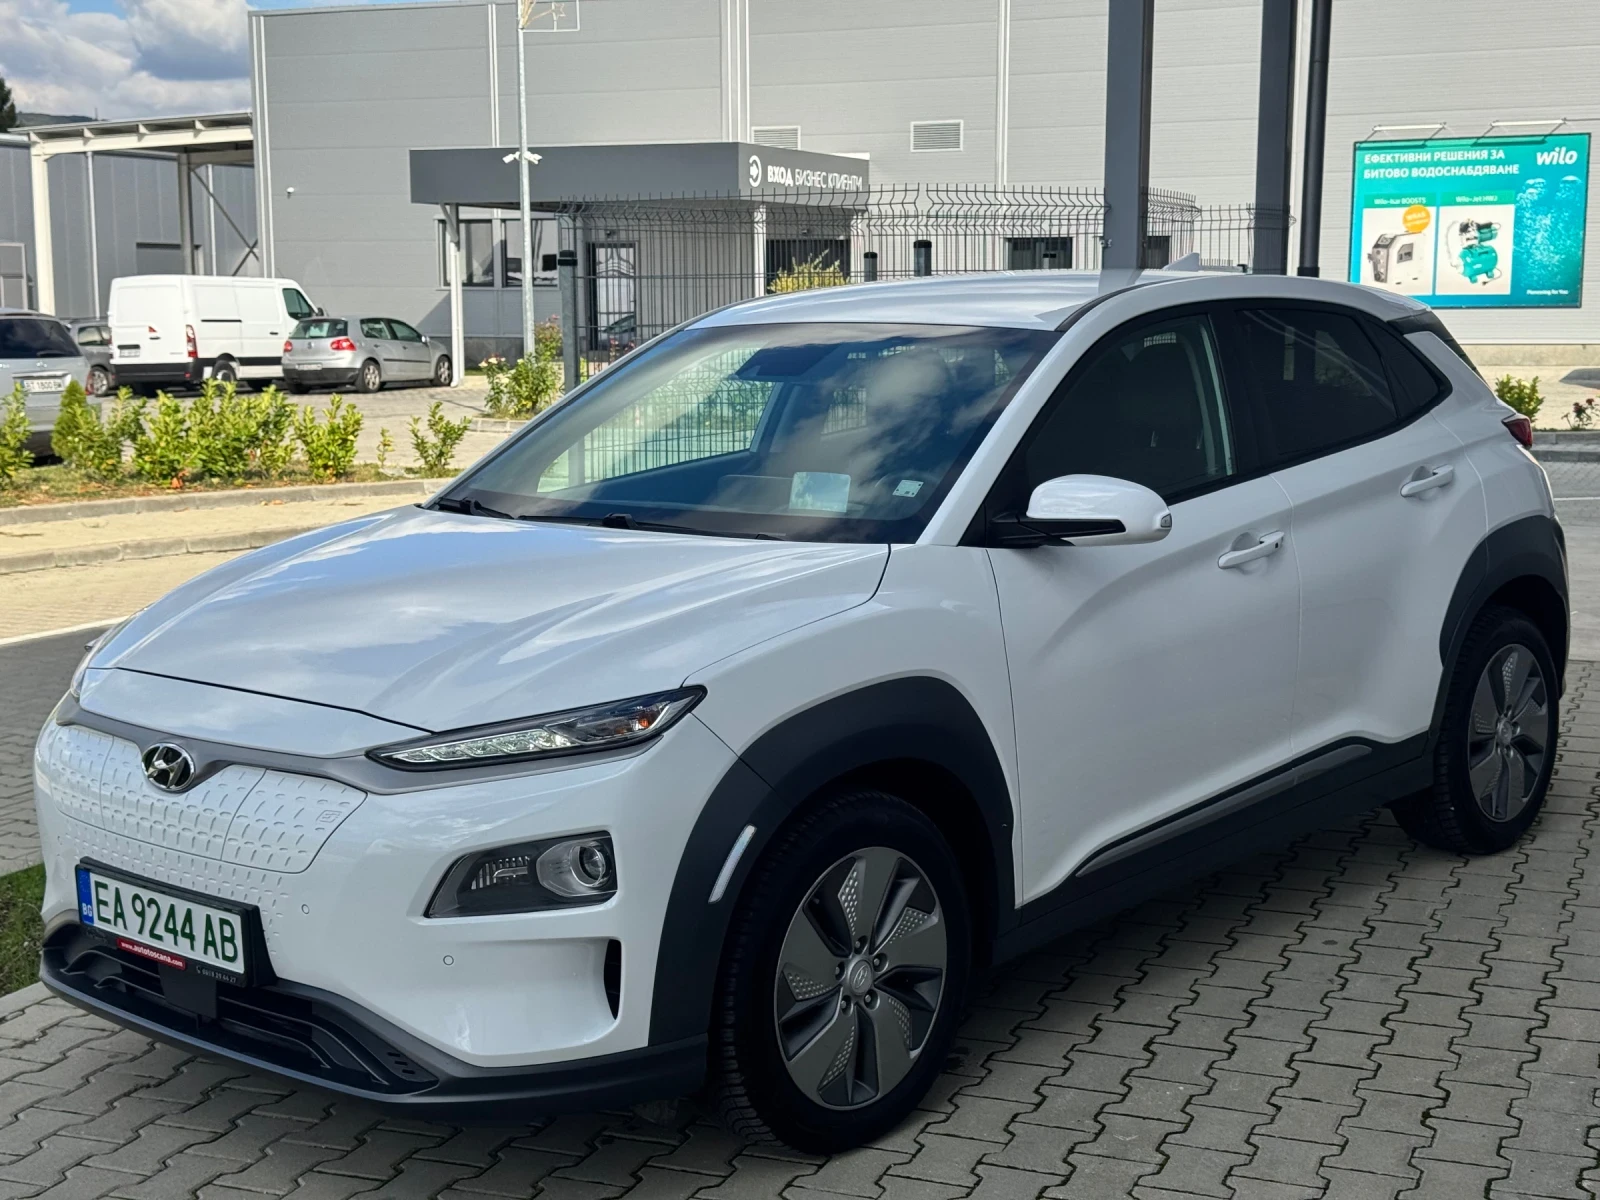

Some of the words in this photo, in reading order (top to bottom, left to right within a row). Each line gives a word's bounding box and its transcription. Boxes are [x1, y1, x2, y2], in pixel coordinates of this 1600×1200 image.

[1364, 152, 1431, 164] ЕФЕКТИВНИ
[1433, 150, 1488, 162] РЕШЕНИЯ
[1489, 149, 1505, 160] ЗА
[1536, 146, 1578, 166] wilo
[767, 165, 794, 187] ВХОД
[795, 168, 827, 189] БИЗНЕС
[828, 172, 863, 191] КЛИЕНТИ
[1363, 167, 1409, 179] БИТОВО
[1411, 164, 1520, 178] ВОДОСНАБДЯВАНЕ
[82, 903, 93, 917] BG
[94, 880, 128, 931] EA
[131, 893, 195, 952] 9244
[203, 913, 238, 963] AB
[121, 941, 184, 968] www.autotoscana.com
